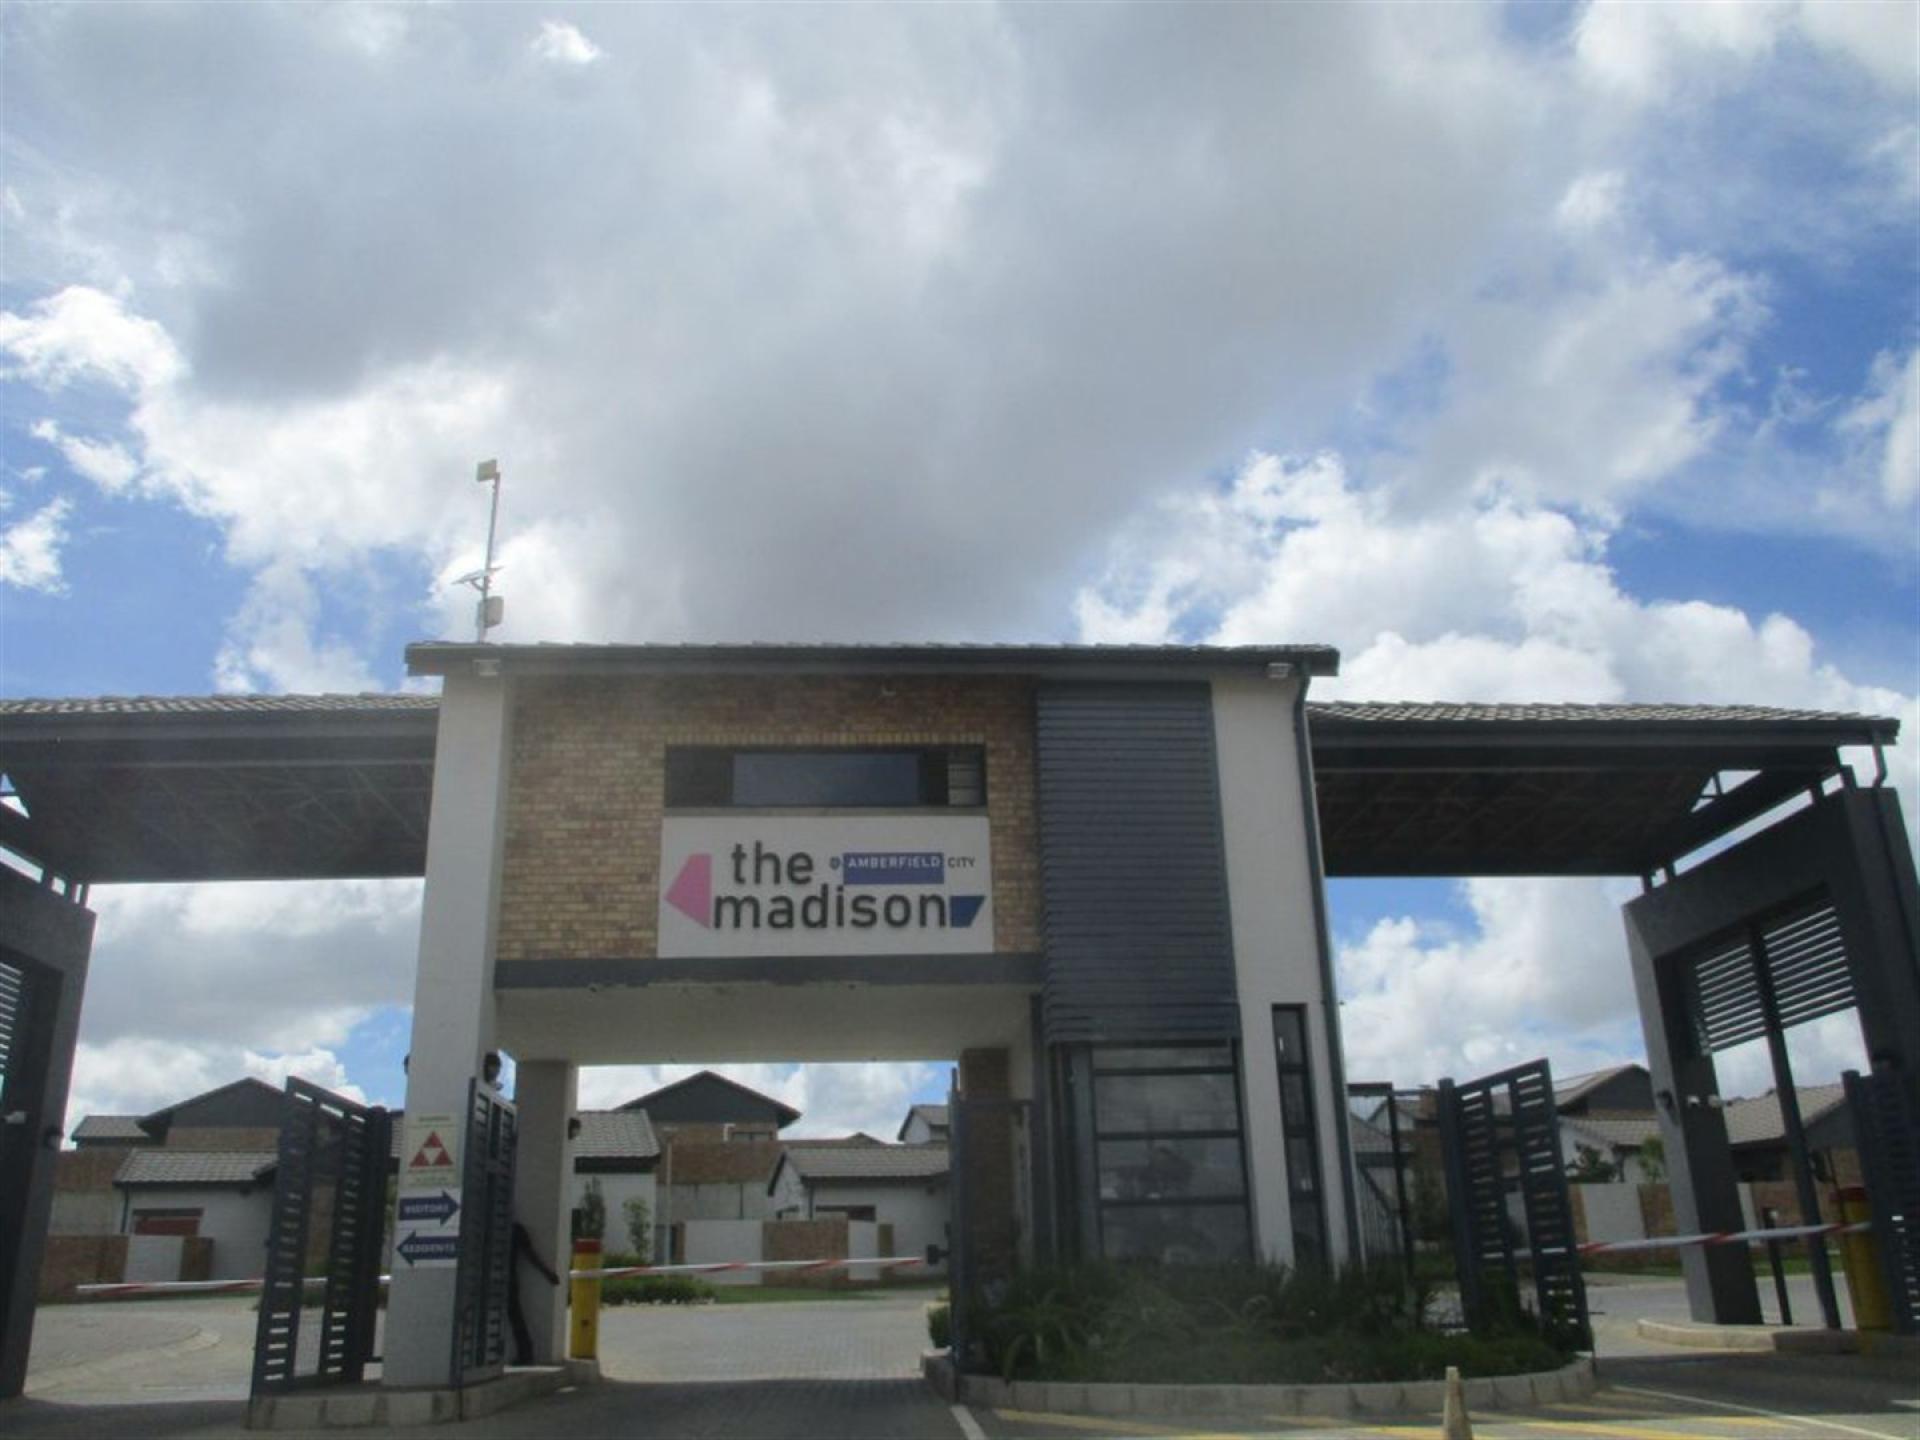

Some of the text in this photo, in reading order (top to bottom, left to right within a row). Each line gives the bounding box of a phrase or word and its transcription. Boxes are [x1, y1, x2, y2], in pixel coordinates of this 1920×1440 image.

[731, 841, 814, 885] the
[847, 855, 942, 870] AMBERFIELD
[947, 856, 976, 869] CITY
[713, 883, 947, 929] madison
